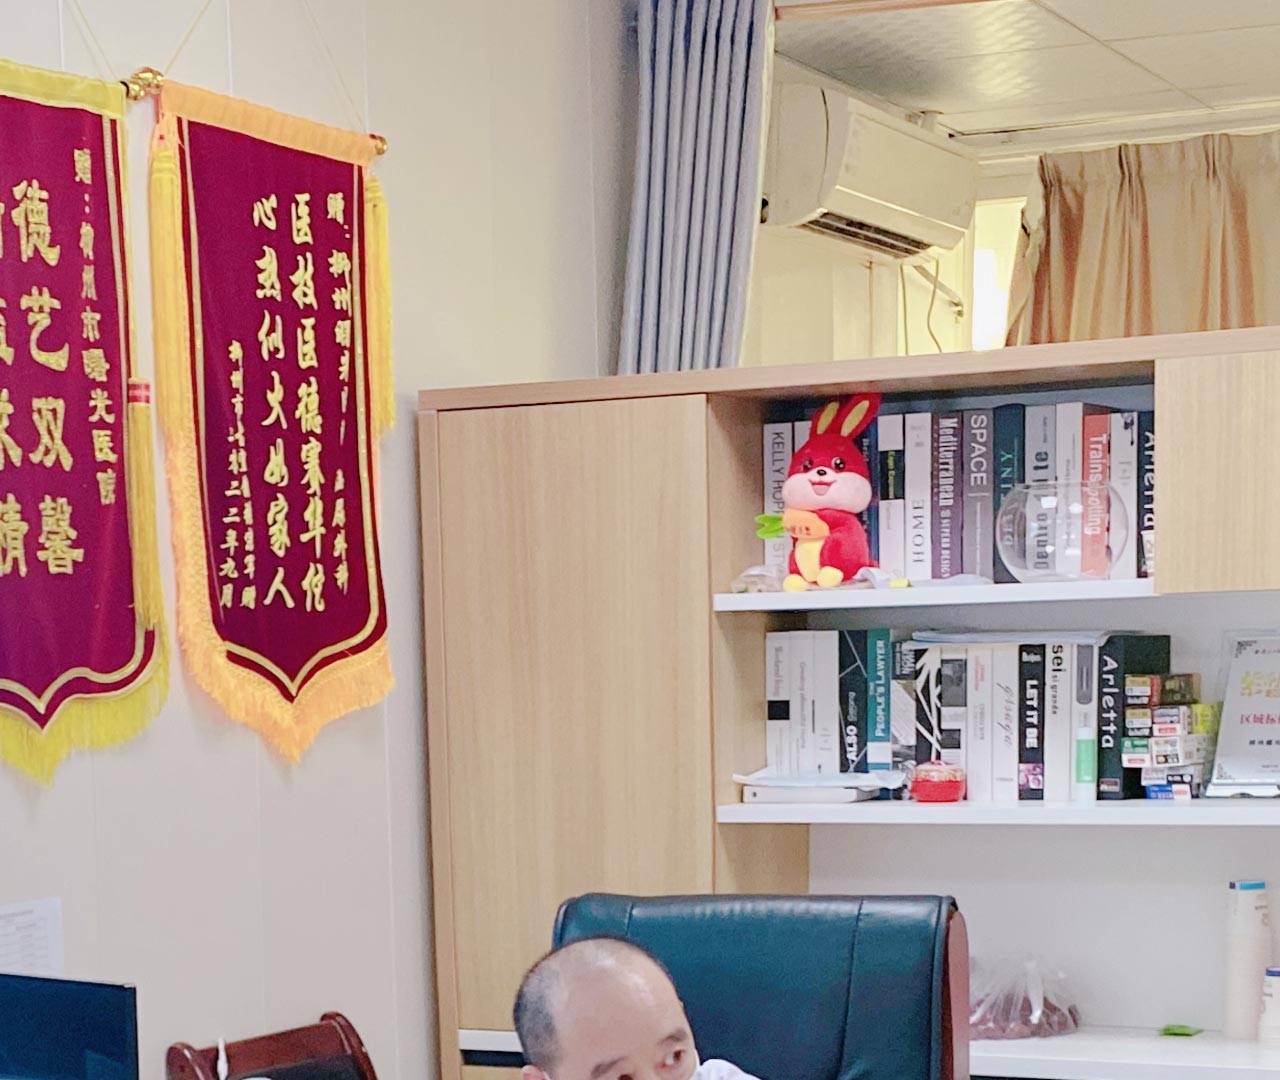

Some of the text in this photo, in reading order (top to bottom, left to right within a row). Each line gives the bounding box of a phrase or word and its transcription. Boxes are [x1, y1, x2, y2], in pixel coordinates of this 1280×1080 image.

[11, 179, 84, 575] 德艺双馨
[772, 431, 785, 477] KELLY
[939, 417, 958, 507] Mediterranean
[970, 414, 988, 487] SPACE
[912, 499, 925, 564] HOME
[875, 640, 885, 684] LAWYER
[1051, 645, 1067, 672] sei
[1025, 679, 1038, 749] LET IT BE
[1101, 655, 1120, 749] Arletta
[846, 725, 858, 762] ALSO
